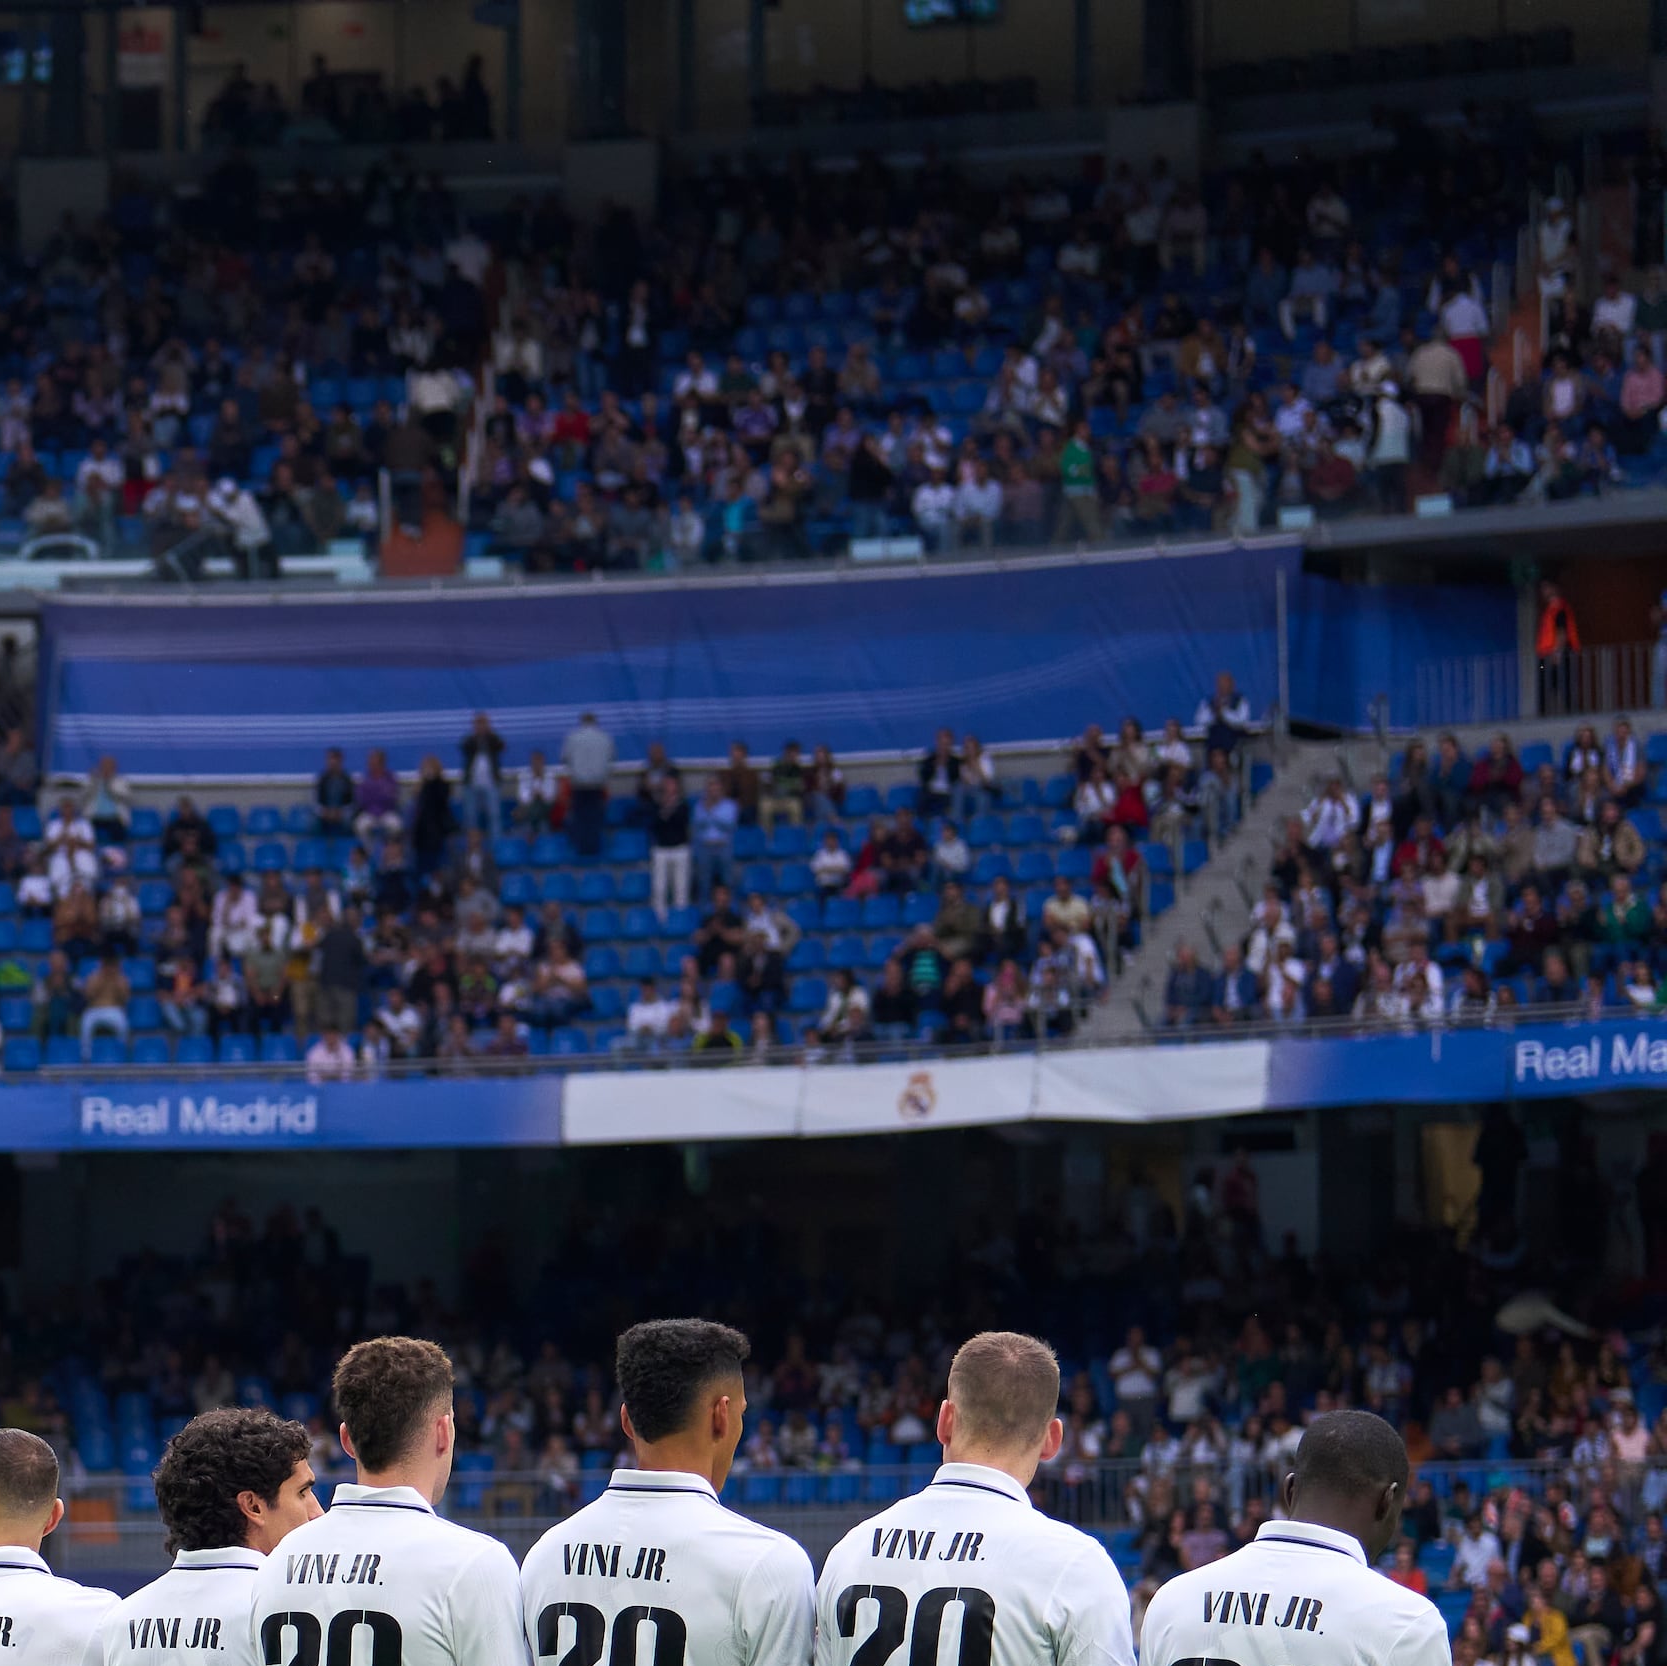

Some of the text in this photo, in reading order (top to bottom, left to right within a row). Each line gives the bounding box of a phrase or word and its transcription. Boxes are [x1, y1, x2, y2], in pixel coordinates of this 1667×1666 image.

[1514, 1036, 1602, 1083] Real
[81, 1094, 319, 1137] Real Madrid
[564, 1544, 670, 1583] VINI JR.
[872, 1528, 985, 1562] VINI JR.
[286, 1554, 383, 1586] VINI JR.
[1204, 1591, 1324, 1636] VINI JR.
[129, 1617, 225, 1650] VINI JR.
